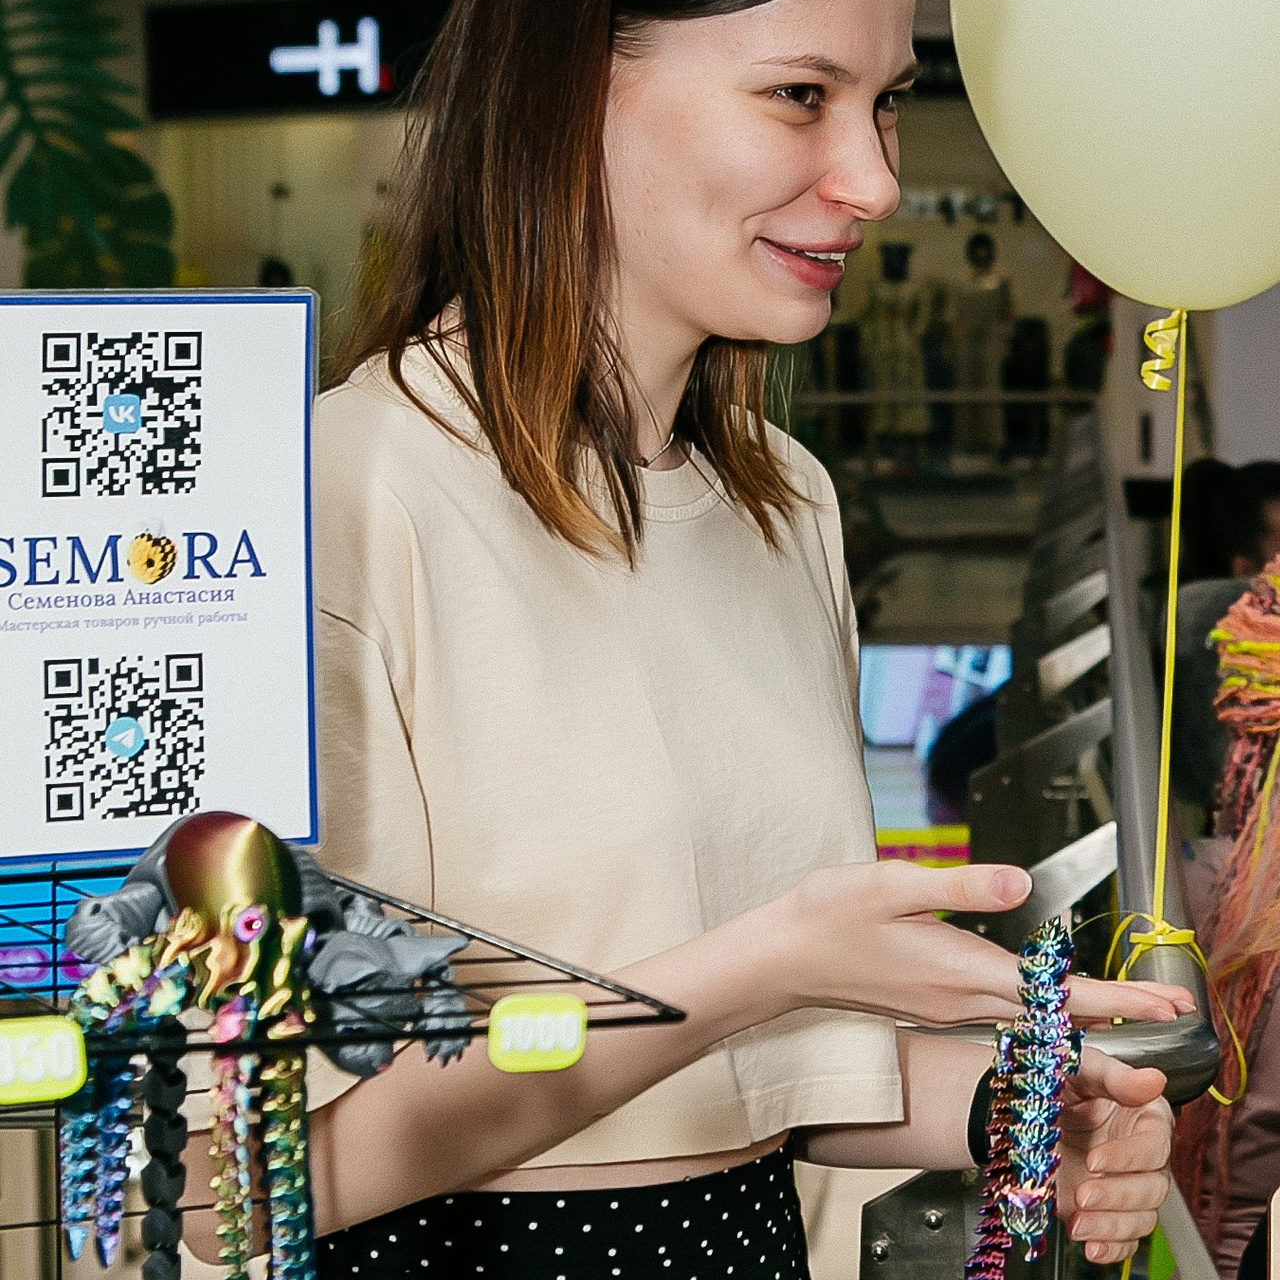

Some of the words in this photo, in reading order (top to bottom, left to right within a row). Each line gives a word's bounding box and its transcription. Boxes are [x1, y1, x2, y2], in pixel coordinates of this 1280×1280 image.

[8, 592, 116, 610] Семенова
[123, 588, 235, 606] Анастасия
[84, 616, 140, 630] товаров
[143, 612, 194, 629] ручной
[198, 611, 248, 626] работы
[499, 1011, 580, 1052] 1000
